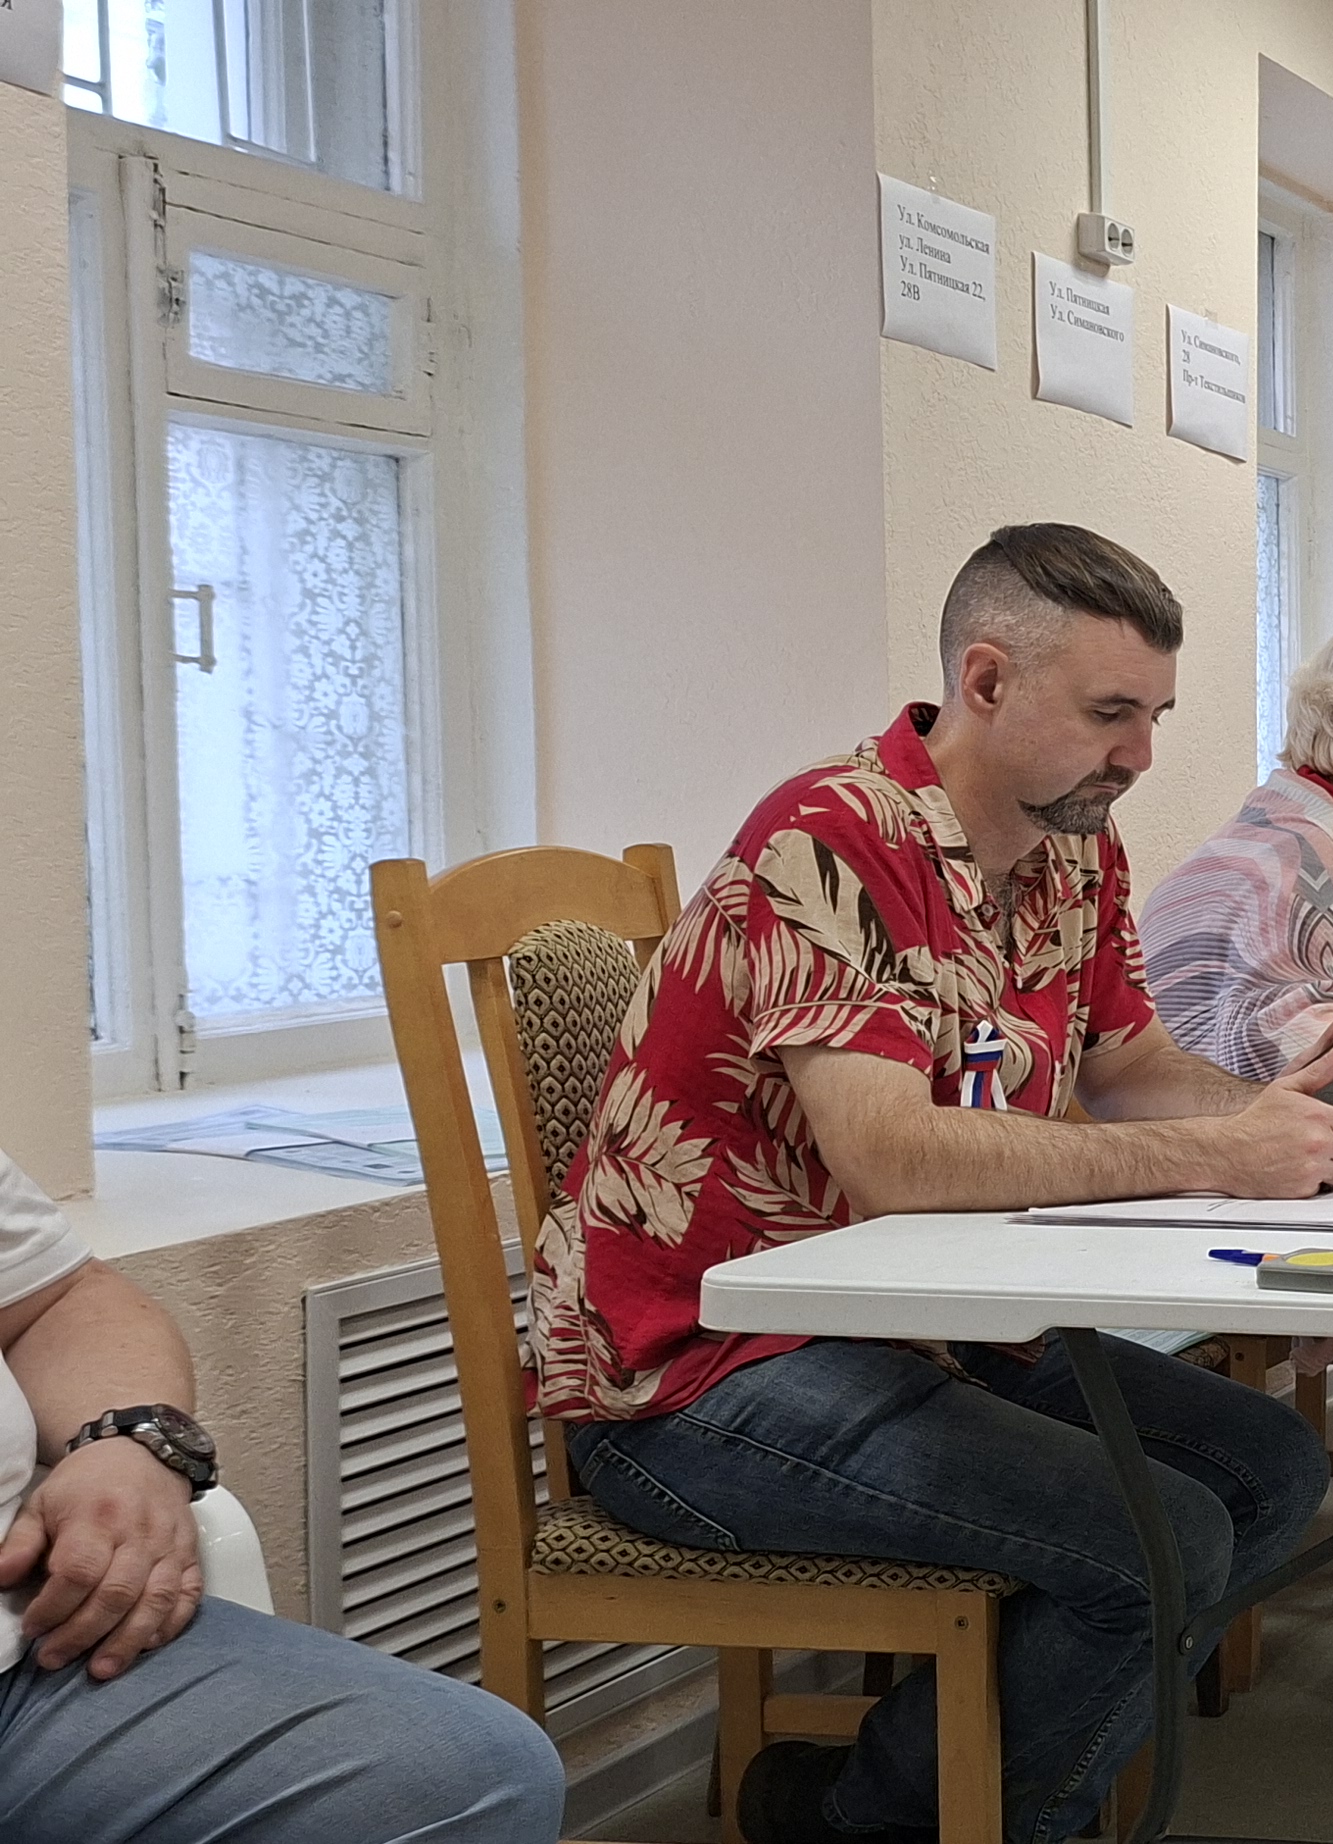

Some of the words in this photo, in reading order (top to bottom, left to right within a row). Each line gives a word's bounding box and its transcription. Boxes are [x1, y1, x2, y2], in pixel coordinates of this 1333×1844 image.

[897, 204, 915, 226] Ул.
[917, 212, 990, 255] Комсомольская
[899, 234, 914, 250] ул.
[915, 237, 952, 264] Ленина
[900, 255, 917, 276] Ул.
[919, 262, 971, 295] Пятницкая
[972, 281, 986, 302] 22,
[901, 280, 920, 301] 28В
[1049, 281, 1065, 300] Ул.
[1066, 287, 1110, 316] Пятницкая
[1050, 304, 1066, 323] Ул.
[1067, 310, 1125, 342] Симановского
